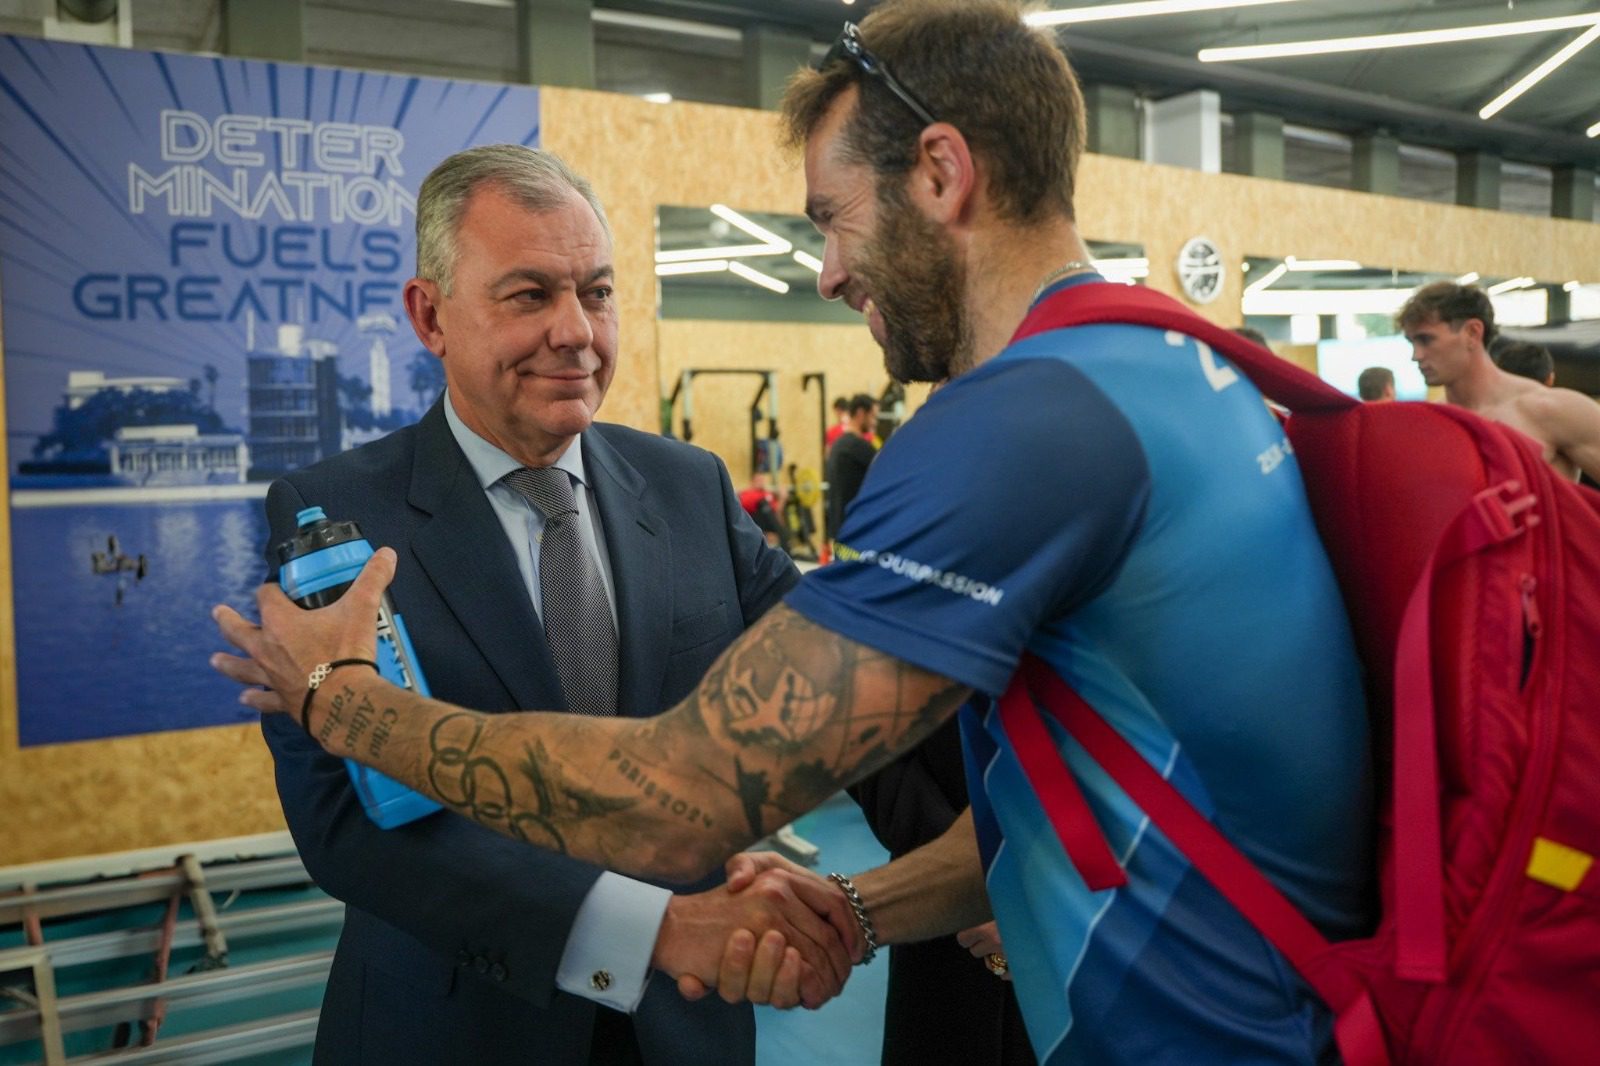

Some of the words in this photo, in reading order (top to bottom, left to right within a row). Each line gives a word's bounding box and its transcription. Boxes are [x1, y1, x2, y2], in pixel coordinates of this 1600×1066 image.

[160, 109, 405, 176] DETER
[169, 222, 402, 273] FUELS
[72, 274, 401, 323] GREATNE
